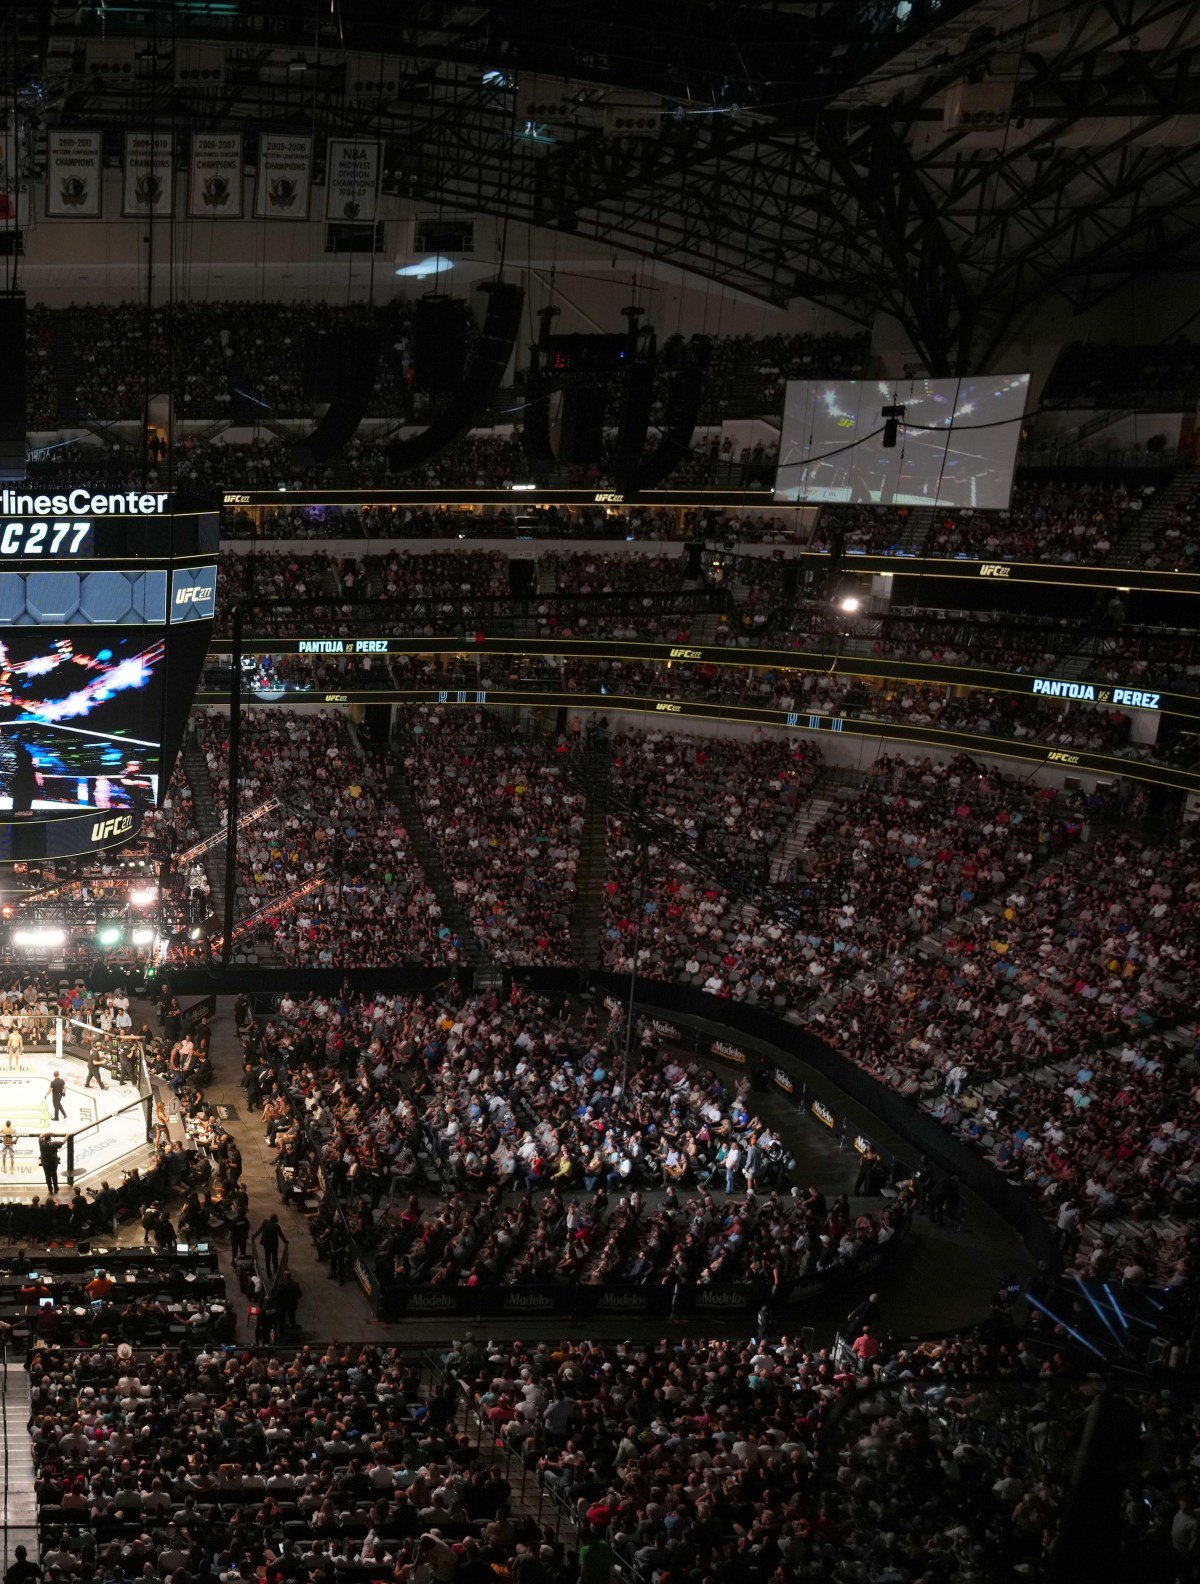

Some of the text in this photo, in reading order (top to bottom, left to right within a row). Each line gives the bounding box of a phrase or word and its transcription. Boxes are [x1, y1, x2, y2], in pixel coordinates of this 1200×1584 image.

[59, 138, 92, 147] 2010-2011
[343, 148, 367, 160] NBA
[55, 158, 95, 167] CHAMPIONS
[197, 160, 237, 169] CHAMPIONS
[265, 162, 306, 170] CHAMPIONS
[299, 641, 388, 653] PANTOJA VS PEREZ
[1032, 679, 1095, 701] PANTOJA
[1112, 688, 1161, 709] PEREZ
[715, 1041, 743, 1058] Modelo
[412, 1294, 452, 1306] Modelo
[509, 1293, 548, 1306] Modelo
[603, 1293, 642, 1306] Modelo
[702, 1291, 742, 1304] Modelo
